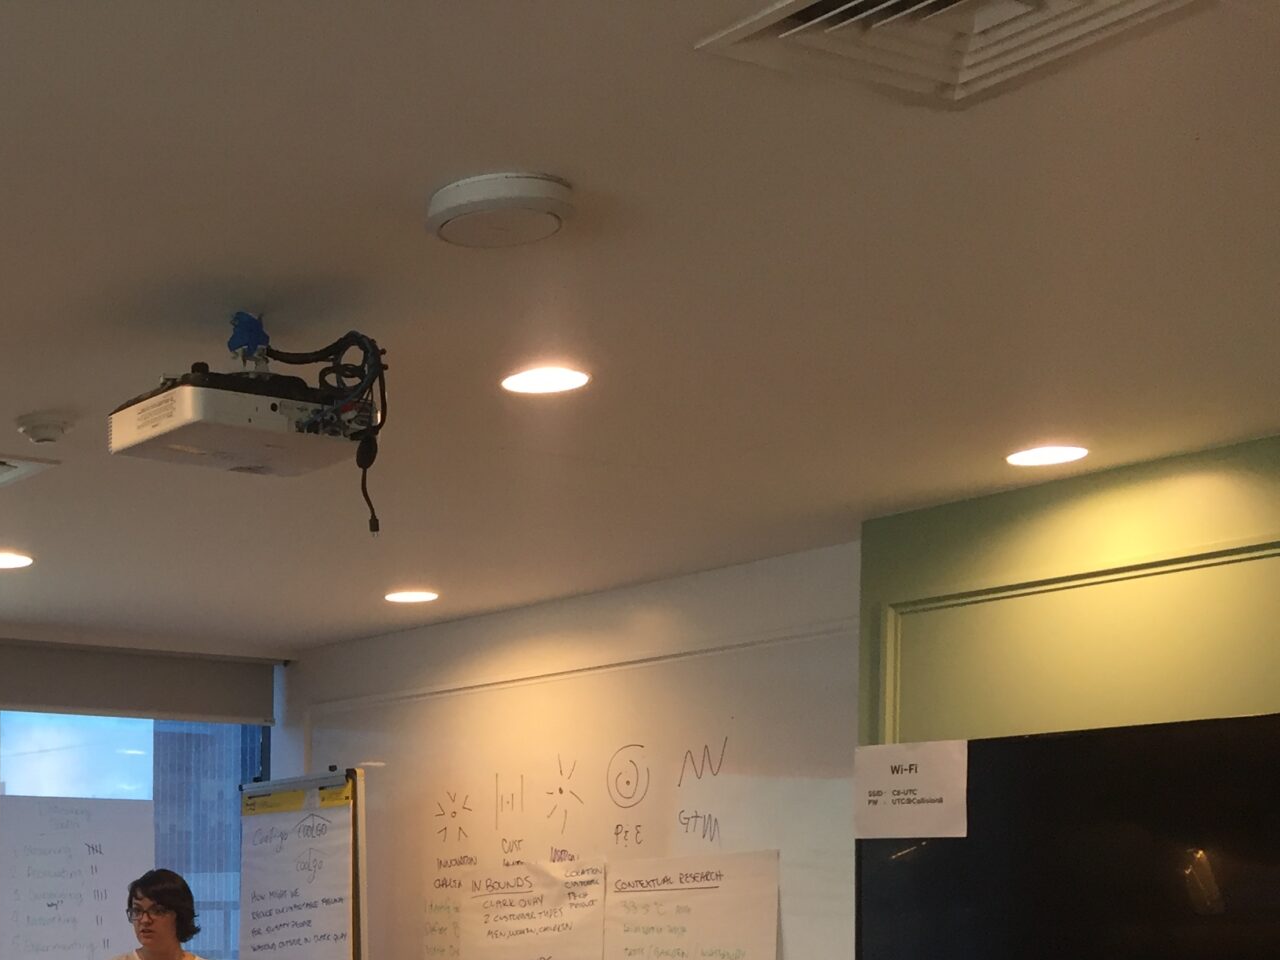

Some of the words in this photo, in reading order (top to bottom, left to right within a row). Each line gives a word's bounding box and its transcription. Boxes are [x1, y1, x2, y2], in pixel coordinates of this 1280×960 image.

[890, 763, 918, 775] Wi-Fi
[472, 879, 482, 892] IN
[485, 876, 533, 892] BOUNDS
[614, 876, 673, 890] CONTEXTUAL
[679, 870, 724, 884] RESEARCH
[482, 897, 515, 909] CLARK
